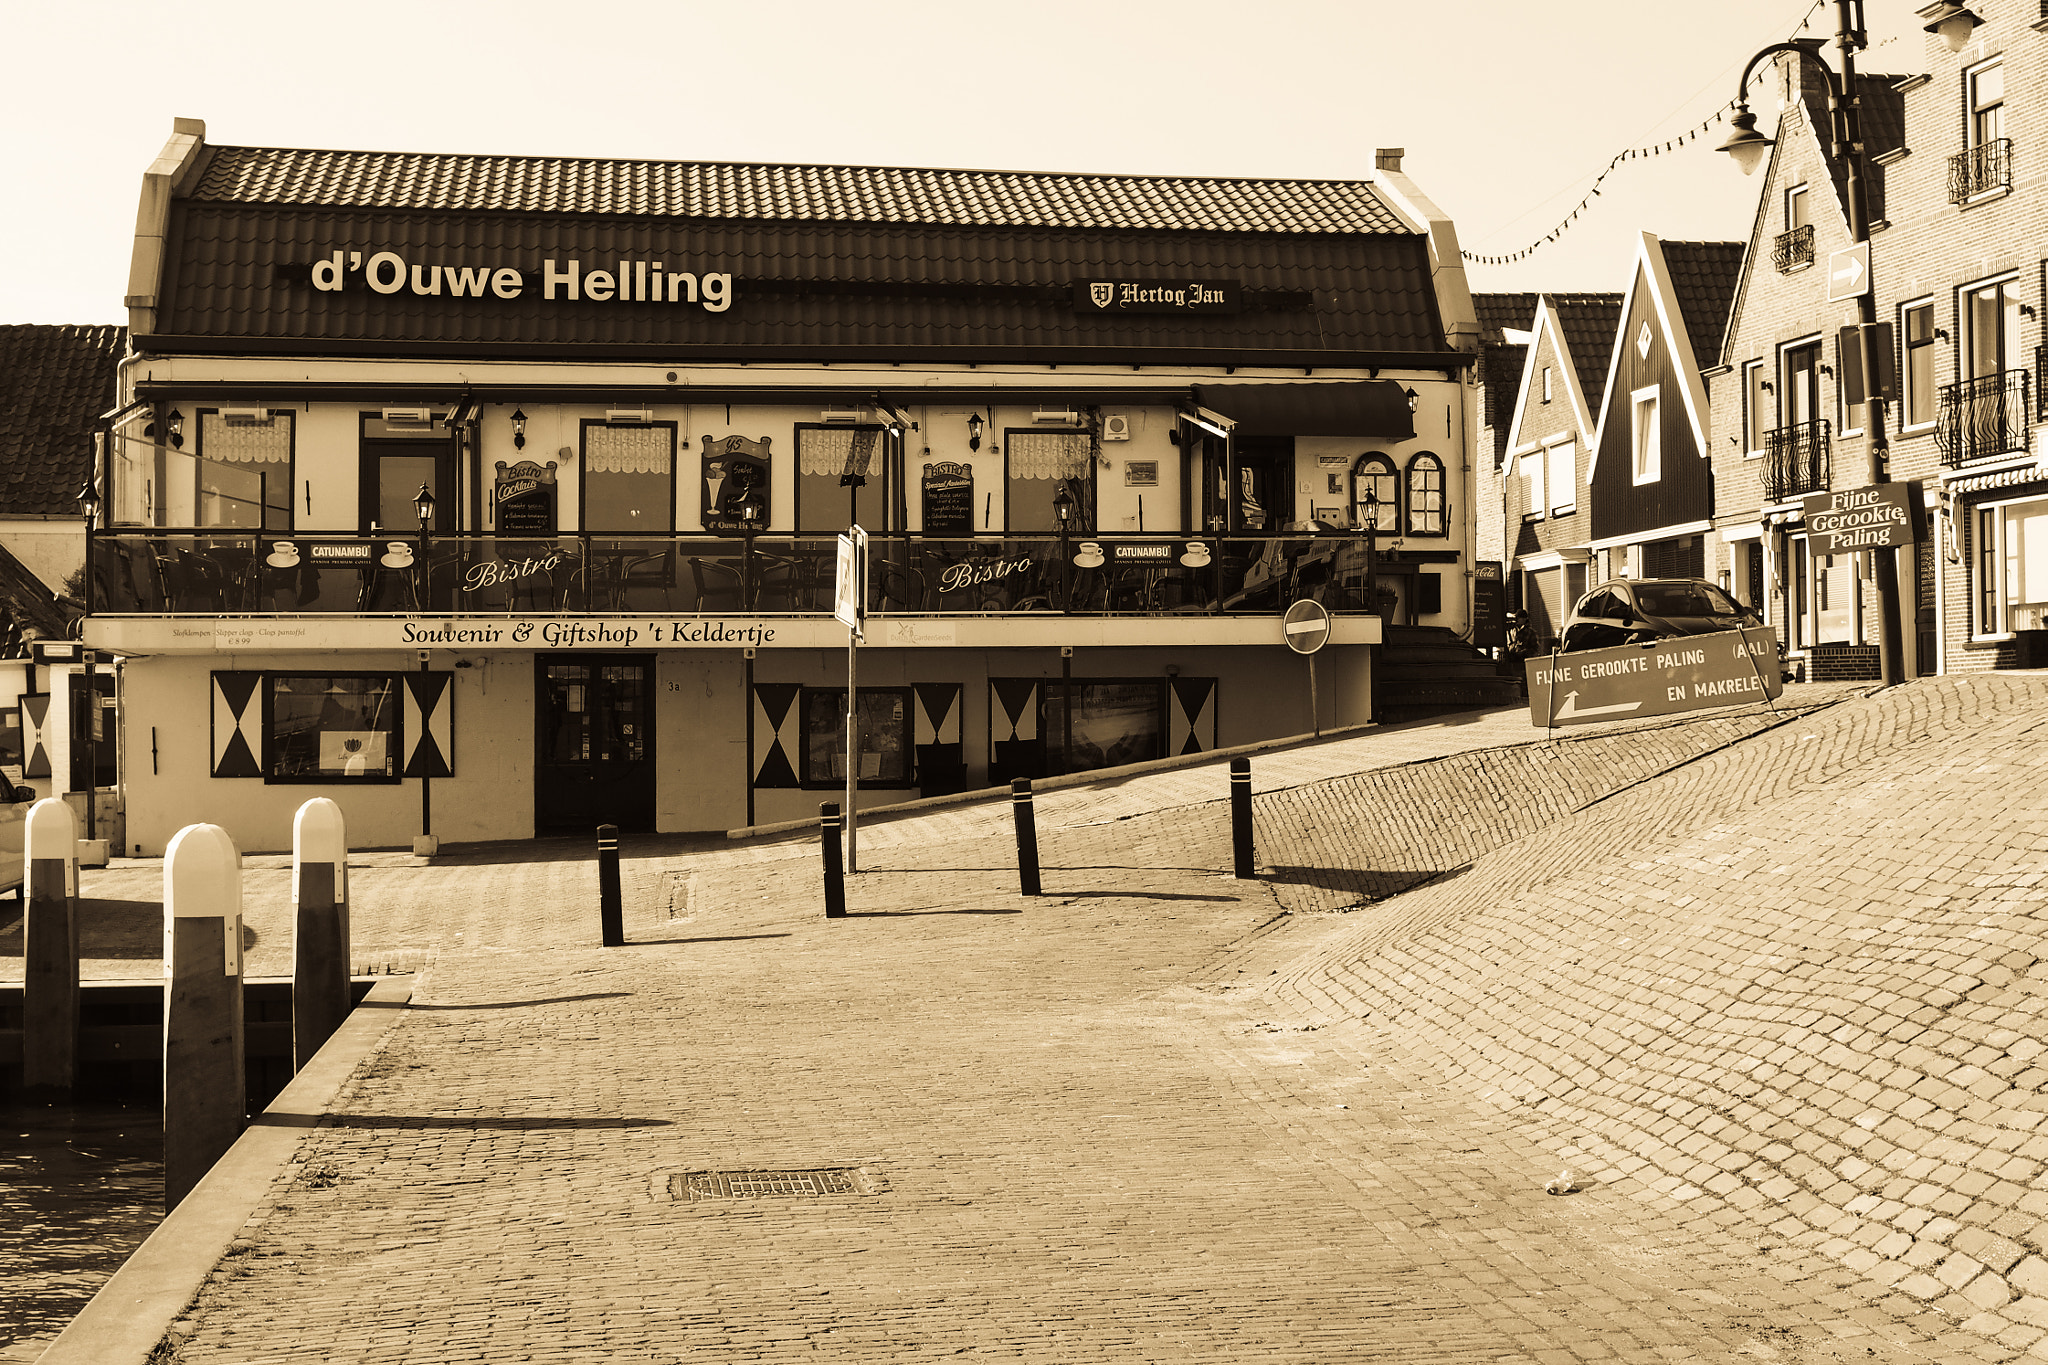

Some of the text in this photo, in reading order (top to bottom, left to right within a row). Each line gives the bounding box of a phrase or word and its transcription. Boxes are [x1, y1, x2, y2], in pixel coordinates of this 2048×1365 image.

[311, 250, 732, 312] d'Ouwe Helling
[1119, 283, 1225, 308] Hertog Jan
[508, 466, 541, 479] Bistro
[932, 464, 962, 476] BISTRO
[498, 480, 537, 500] Cocktails
[1831, 490, 1880, 511] Fijne
[1812, 506, 1904, 532] Gerookte
[1829, 527, 1891, 549] Paling
[462, 556, 560, 592] Bistro
[939, 558, 1034, 593] Bistro
[402, 622, 775, 647] Souvenir & Giftshop 't Keldertje
[1536, 640, 1770, 686] FIJNE GEROOKTE PALING (AAL)
[668, 682, 680, 691] 3a
[1667, 675, 1770, 702] EN MAKRELEN
